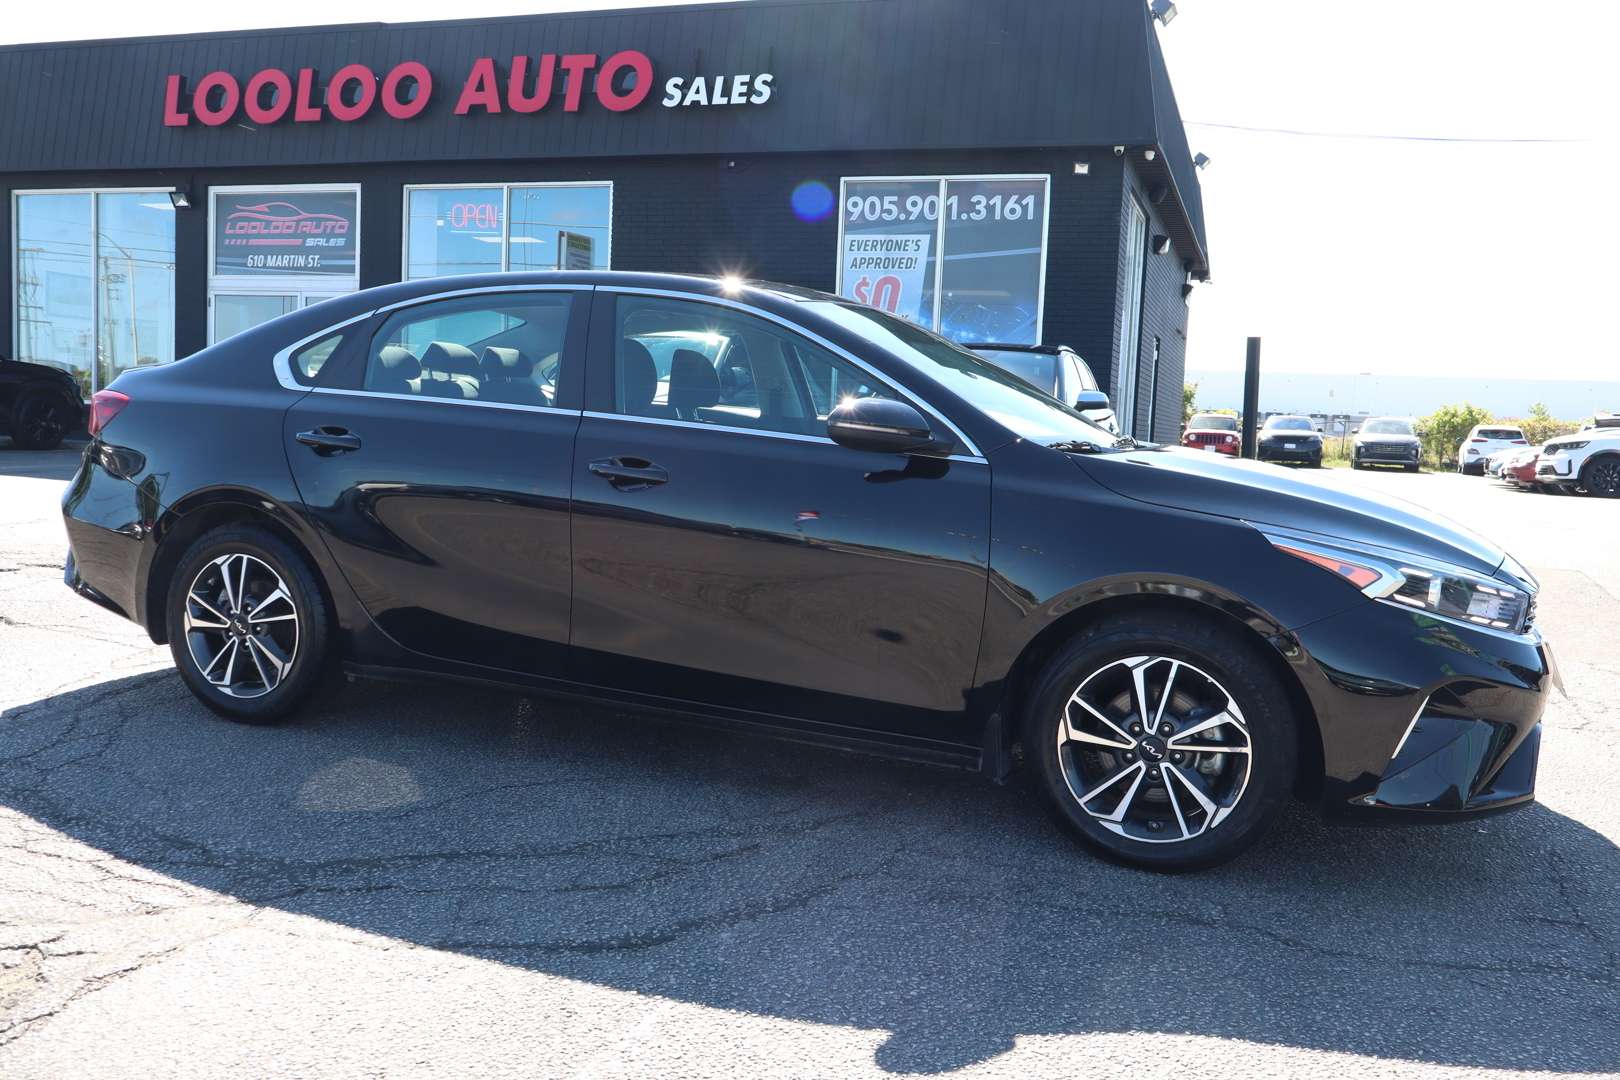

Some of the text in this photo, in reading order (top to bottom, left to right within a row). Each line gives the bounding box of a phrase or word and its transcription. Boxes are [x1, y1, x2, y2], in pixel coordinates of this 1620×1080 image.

[164, 50, 774, 127] LOOLOO AUTO SALES
[846, 195, 1035, 221] 905.901.3161
[451, 203, 497, 228] OPEN
[224, 221, 349, 234] LOOLOO AUTO
[305, 238, 346, 246] SALES
[849, 239, 921, 252] EVERYONE'S
[247, 254, 321, 267] 610 MARTIN ST.
[850, 257, 917, 270] APPROVED!
